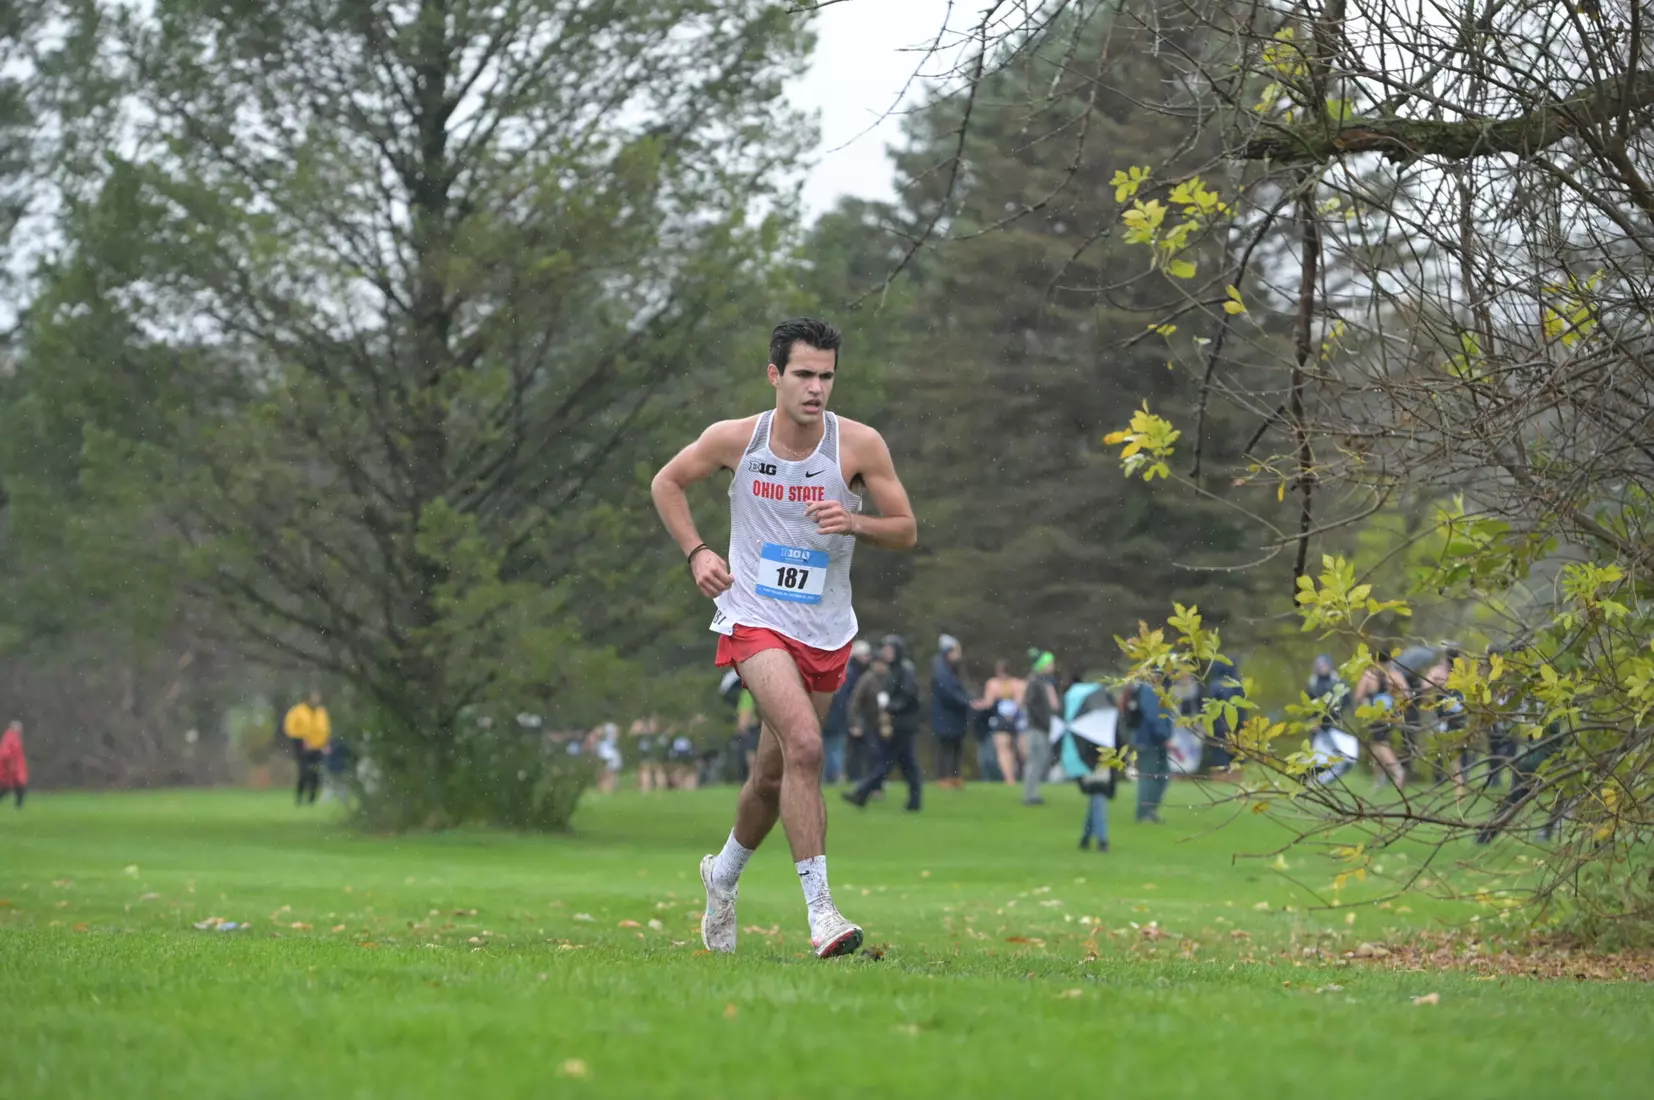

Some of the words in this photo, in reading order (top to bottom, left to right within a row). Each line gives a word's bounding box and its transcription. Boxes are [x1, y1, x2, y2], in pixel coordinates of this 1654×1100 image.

[753, 480, 784, 500] OHIO
[788, 486, 825, 502] STATE
[776, 567, 809, 590] 187
